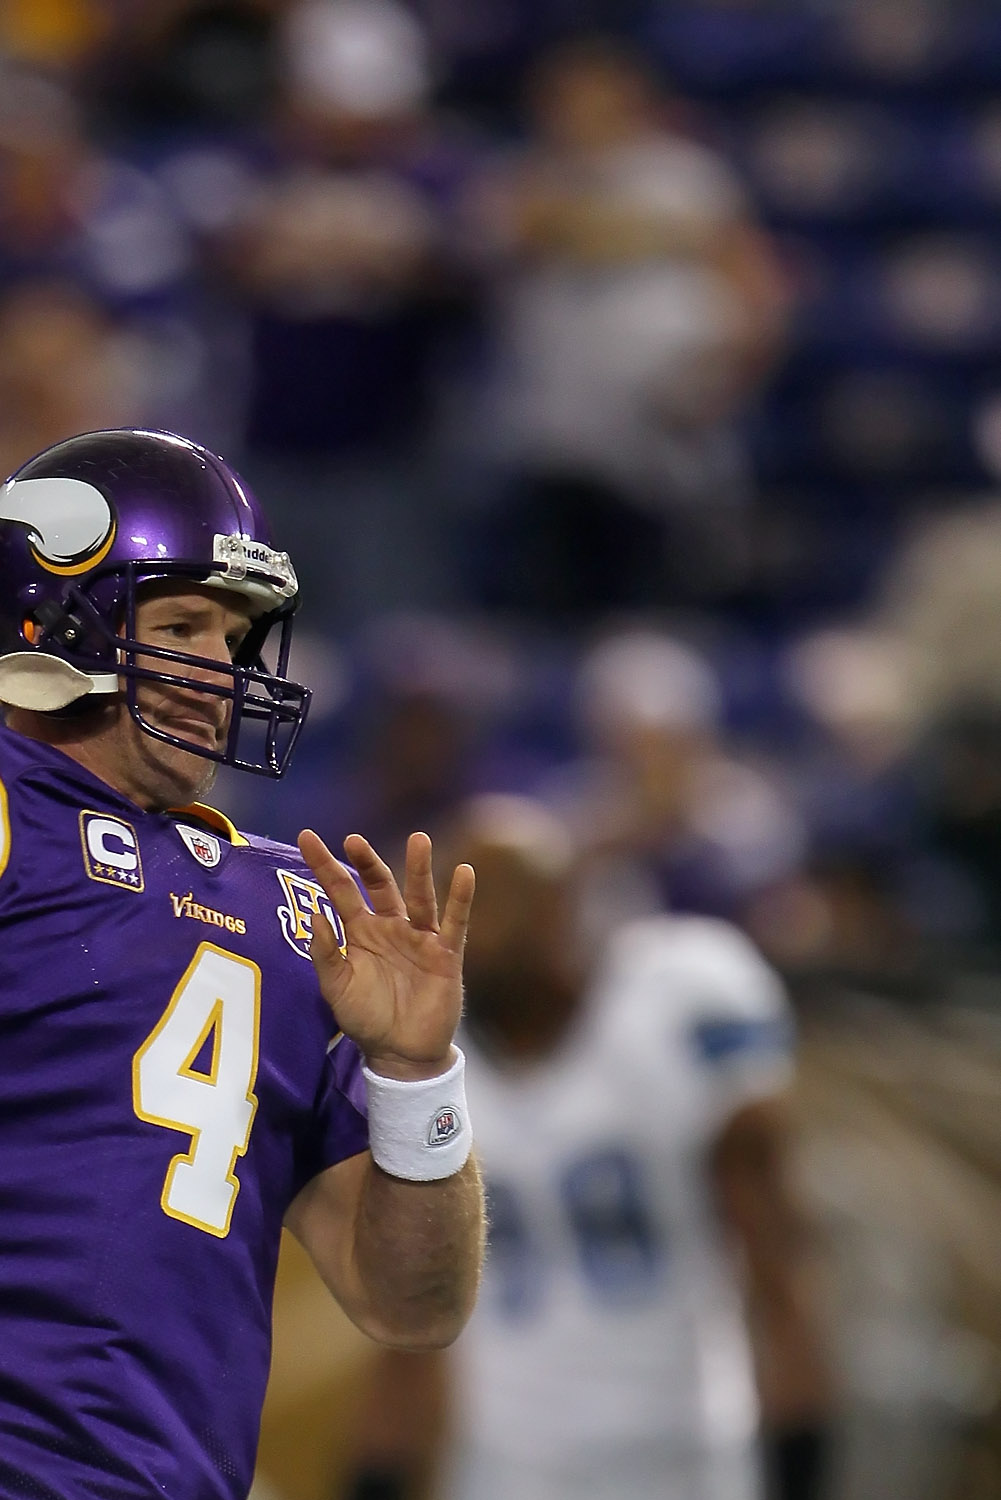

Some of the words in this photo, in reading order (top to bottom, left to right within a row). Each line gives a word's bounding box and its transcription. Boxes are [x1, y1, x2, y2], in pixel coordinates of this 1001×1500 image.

[87, 818, 138, 871] C
[169, 892, 247, 935] VIKINGS
[132, 941, 262, 1239] 4
